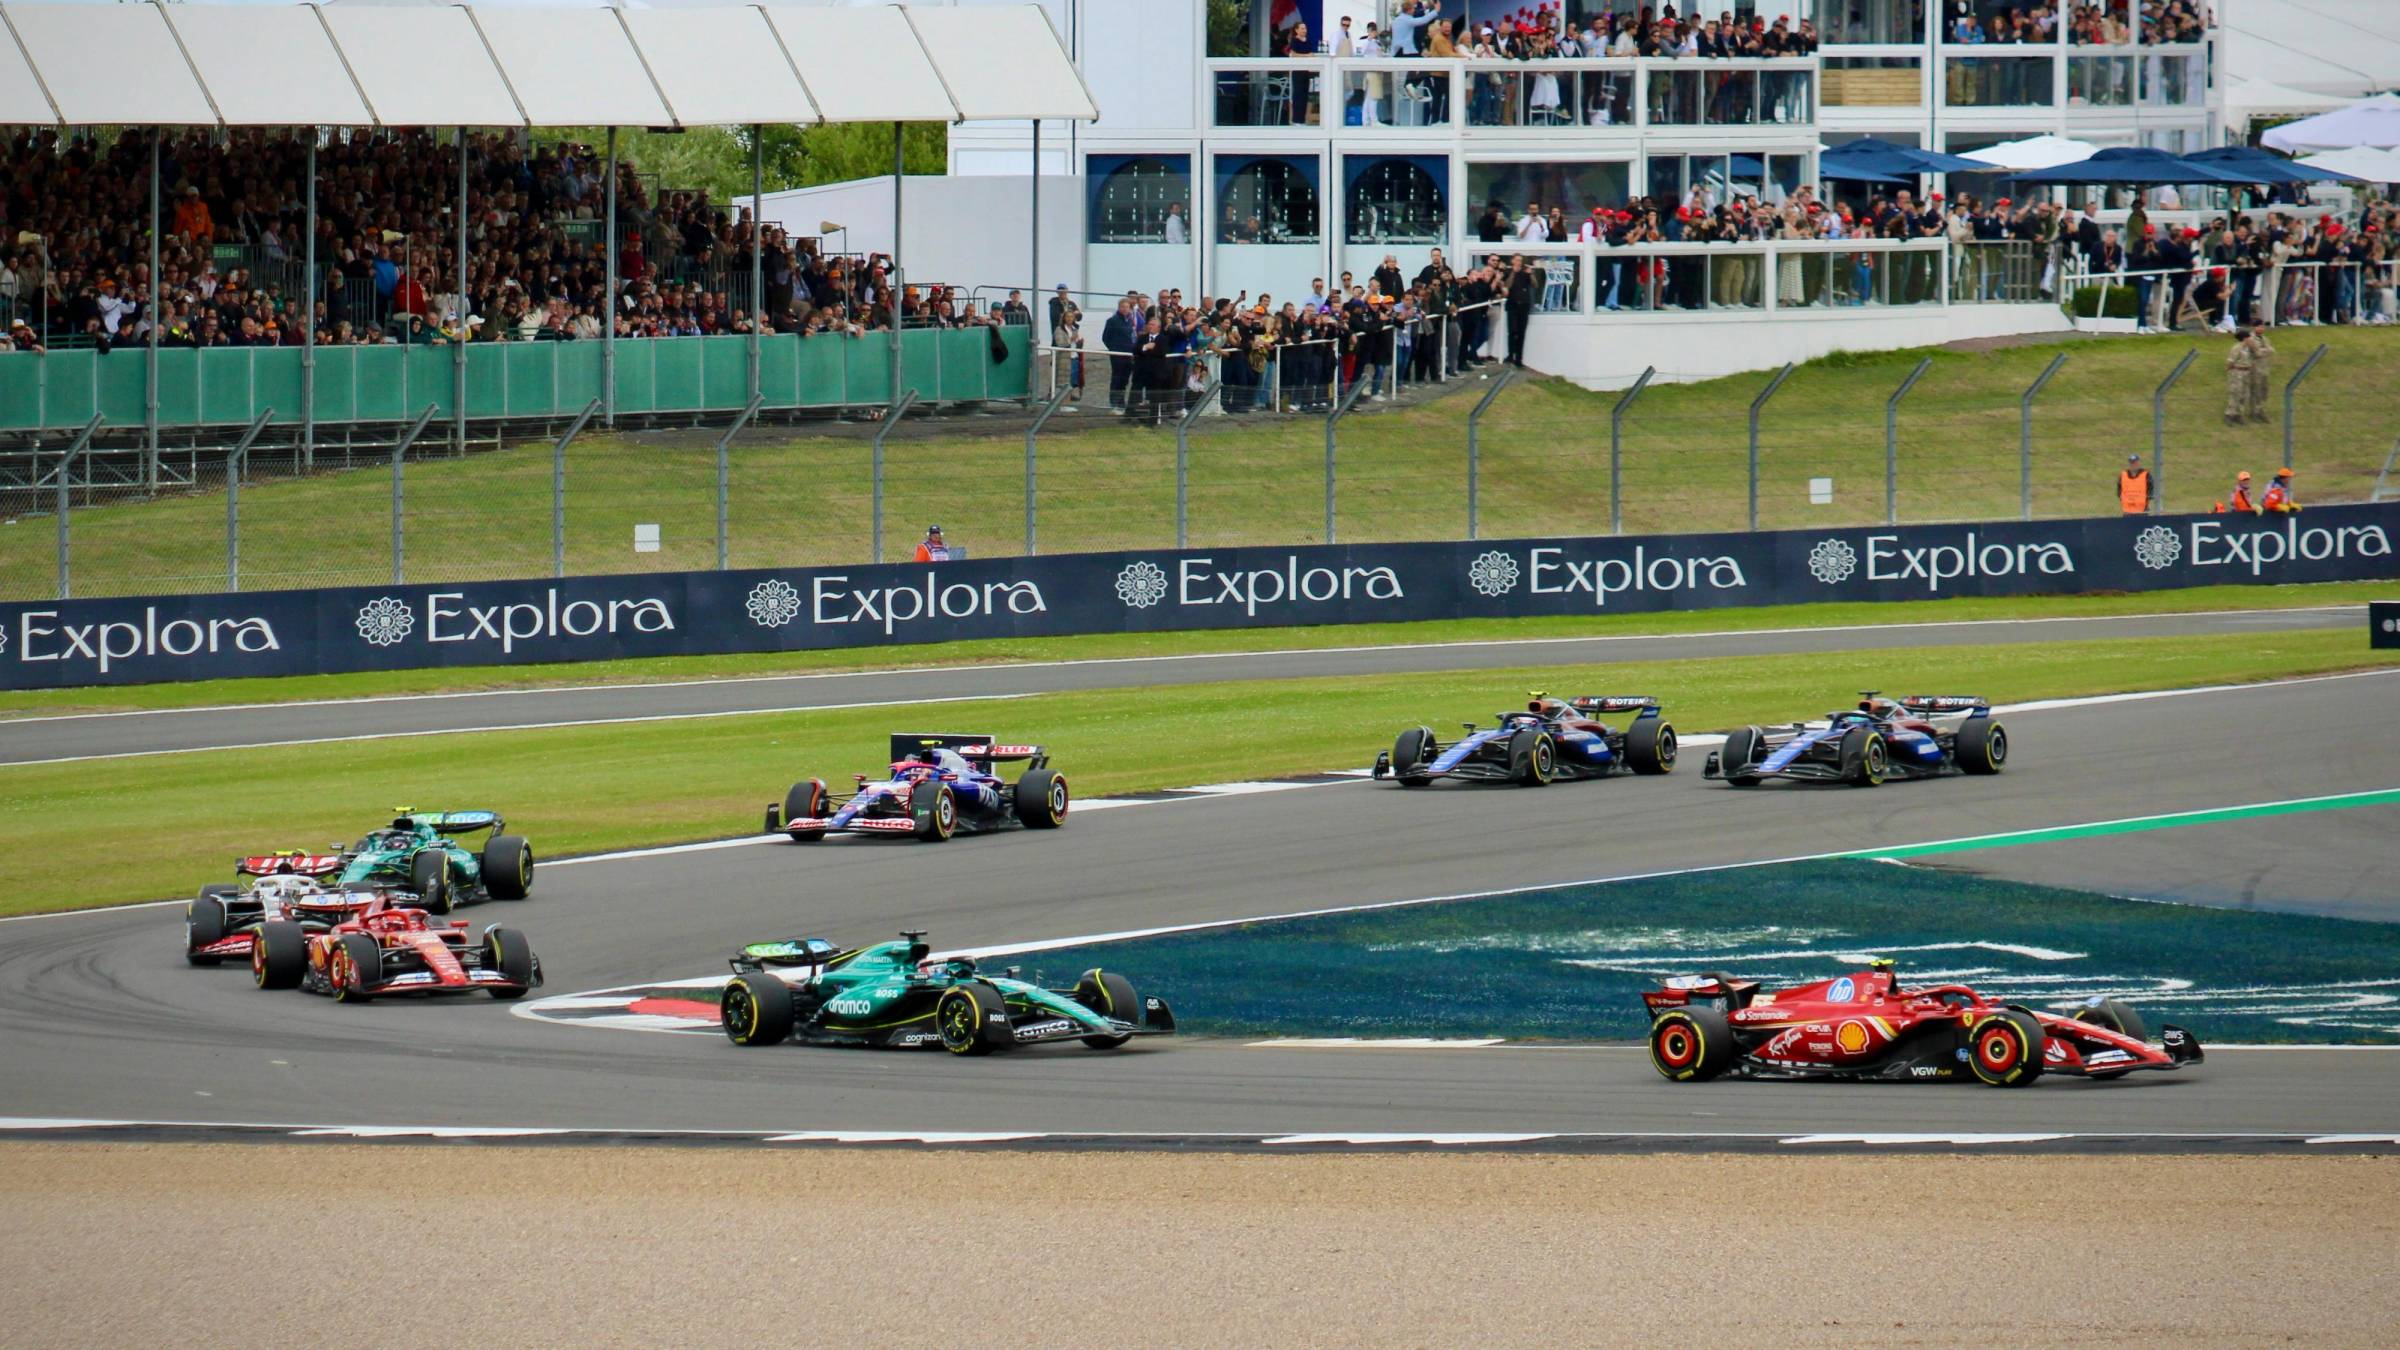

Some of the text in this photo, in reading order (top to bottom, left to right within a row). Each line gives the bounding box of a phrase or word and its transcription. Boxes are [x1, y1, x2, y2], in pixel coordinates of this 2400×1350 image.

[2192, 518, 2391, 575] Explora
[1531, 535, 1746, 606] Explora
[1868, 532, 2073, 591] Explora
[1180, 556, 1404, 617] Explora
[813, 572, 1047, 635] Explora
[428, 589, 675, 653] Explora
[21, 607, 280, 673] Explora
[1827, 977, 1855, 1003] hp
[828, 999, 871, 1015] aramco
[989, 1013, 1005, 1022] BOSS
[1747, 1010, 1792, 1021] Santander
[905, 1032, 941, 1044] cognizan
[1014, 1020, 1069, 1038] ramco
[1768, 1027, 1804, 1056] Ray-Ban
[2164, 1029, 2184, 1040] aws
[1910, 1066, 1937, 1077] VGW
